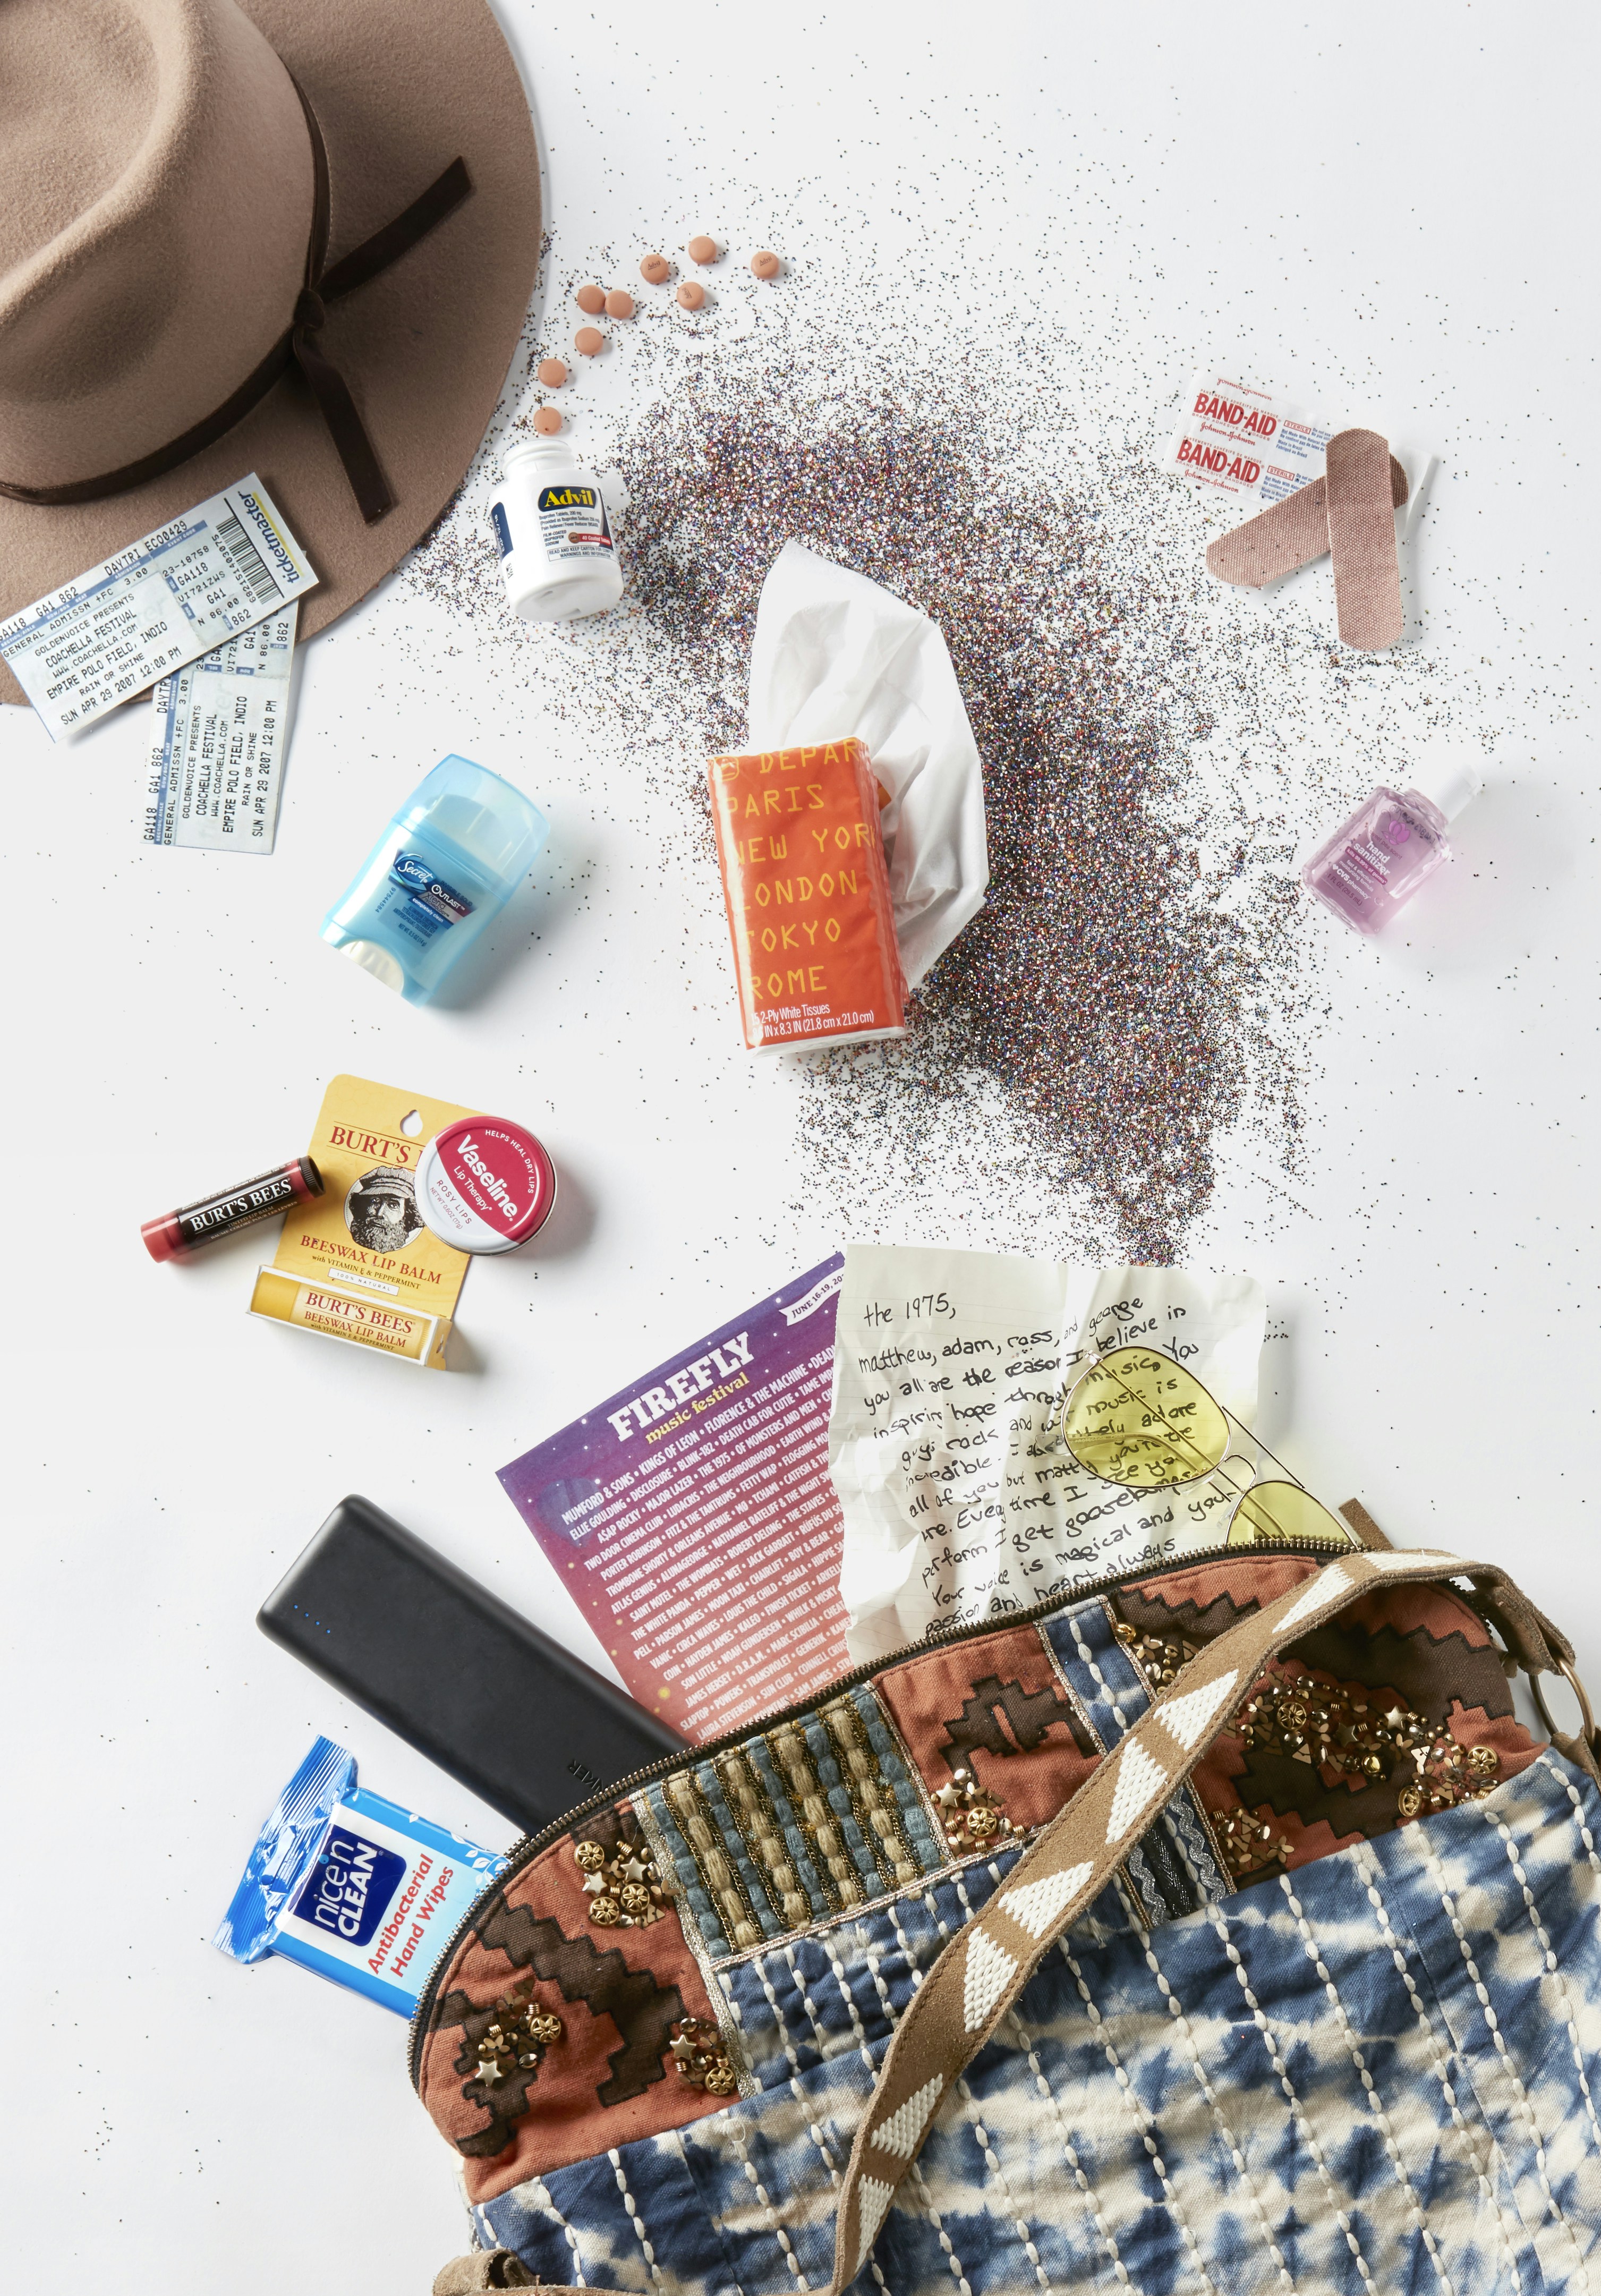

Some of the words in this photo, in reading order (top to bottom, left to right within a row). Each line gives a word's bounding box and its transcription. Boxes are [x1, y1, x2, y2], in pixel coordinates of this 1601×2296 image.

[1194, 393, 1276, 436] BAND-AID
[1286, 422, 1310, 433] STERILE
[1177, 439, 1260, 483] BAND-AID
[1270, 469, 1293, 479] STERILE
[545, 489, 594, 507] Advil
[239, 494, 299, 583] ticketmaster
[59, 587, 81, 606] 862
[104, 549, 143, 578] DAYTRI
[3, 631, 45, 657] GENERAL
[50, 602, 90, 630] ADMISSN
[125, 568, 147, 585] 3.00
[35, 620, 90, 656] GOLDENVOICE
[93, 594, 134, 622] PRESENTS
[46, 635, 92, 667] COACHELLA
[94, 610, 137, 639] FESTIVAL
[53, 624, 137, 678] WWW.COACHELLA.COM
[47, 675, 80, 699] EMPIRE
[81, 660, 104, 679] POLO
[106, 642, 137, 664] FIELD,
[140, 622, 167, 643] INDIO
[61, 709, 79, 725] SUN
[82, 698, 98, 713] APR
[100, 688, 112, 701] 29
[115, 674, 136, 693] 2007
[140, 656, 166, 677] 12:00
[168, 647, 181, 660] PM
[234, 696, 247, 724] INDIO
[202, 715, 217, 759] FESTIVAL
[230, 733, 243, 764] FIELD,
[196, 765, 211, 815] COACHELLA
[227, 771, 239, 793] POLO
[223, 799, 236, 832] EMPIRE
[398, 861, 433, 883] Secret
[1353, 844, 1390, 877] sanitizer
[1367, 840, 1391, 863] hand
[1337, 868, 1350, 881] CVS
[1348, 880, 1371, 899] pharmacy
[413, 898, 433, 915] completely
[433, 914, 443, 922] clean
[760, 1009, 778, 1026] 2-Ply
[779, 1007, 801, 1019] White
[801, 1005, 830, 1016] Tissues
[764, 1025, 773, 1037] IN
[774, 1027, 779, 1036] x
[779, 1022, 791, 1035] 8.3
[793, 1021, 802, 1033] IN
[803, 1017, 822, 1032] (21.8
[823, 1018, 835, 1028] cm
[836, 1018, 841, 1026] x
[842, 1012, 858, 1025] 21.0
[860, 1010, 874, 1023] cm)
[329, 1126, 410, 1163] BURT'S
[486, 1129, 509, 1142] HELPS
[510, 1140, 526, 1157] HEAL
[524, 1159, 534, 1173] DRY
[454, 1166, 465, 1179] Lip
[465, 1178, 489, 1211] Therapy
[458, 1135, 517, 1217] Vaseline
[190, 1198, 248, 1231] BURT'S
[251, 1179, 292, 1206] BEES
[437, 1180, 456, 1201] ROSY
[455, 1205, 471, 1223] LIPS
[300, 1235, 368, 1263] BEESWAX
[373, 1255, 396, 1270] LIP
[399, 1263, 441, 1283] BALM
[328, 1258, 359, 1271] VITAMIN
[374, 1272, 421, 1289] PEPPERMINT
[337, 1272, 354, 1282] 100%
[358, 1279, 393, 1291] NATURAL
[792, 1300, 813, 1318] JUNE
[812, 1285, 832, 1302] 16-19,
[306, 1292, 366, 1319] BURT'S
[370, 1311, 412, 1333] BEES
[907, 1293, 956, 1319] 1975,
[305, 1311, 353, 1332] BEESWAX
[356, 1326, 373, 1337] LIP
[376, 1332, 406, 1347] BALM
[942, 1338, 1001, 1358] adam,
[1095, 1317, 1159, 1353] believe
[607, 1332, 754, 1442] FIREFLY
[645, 1409, 691, 1444] music
[692, 1372, 750, 1414] festival
[561, 1492, 604, 1525] MUMFORD
[610, 1473, 634, 1494] SONS
[638, 1452, 666, 1475] KINGS
[665, 1444, 677, 1458] OF
[676, 1431, 700, 1451] LEON
[704, 1401, 747, 1434] FLORENCE
[752, 1387, 772, 1404] THE
[769, 1364, 808, 1394] MACHINE
[569, 1521, 591, 1540] ELLIE
[589, 1499, 627, 1528] GOULDING
[630, 1468, 674, 1501] DISCLOSURE
[677, 1442, 715, 1471] BLINK-182
[645, 1490, 672, 1511] MAJOR
[670, 1475, 694, 1495] LAZER
[697, 1462, 714, 1477] THE
[712, 1452, 730, 1468] 1975
[634, 1644, 652, 1660] PELL
[750, 1558, 784, 1585] CHAIRLIFT
[338, 1842, 378, 1937] CLEAN
[368, 1853, 433, 1974] Antibacterial
[390, 1923, 424, 1977] Hand
[416, 1867, 453, 1920] Wipes
